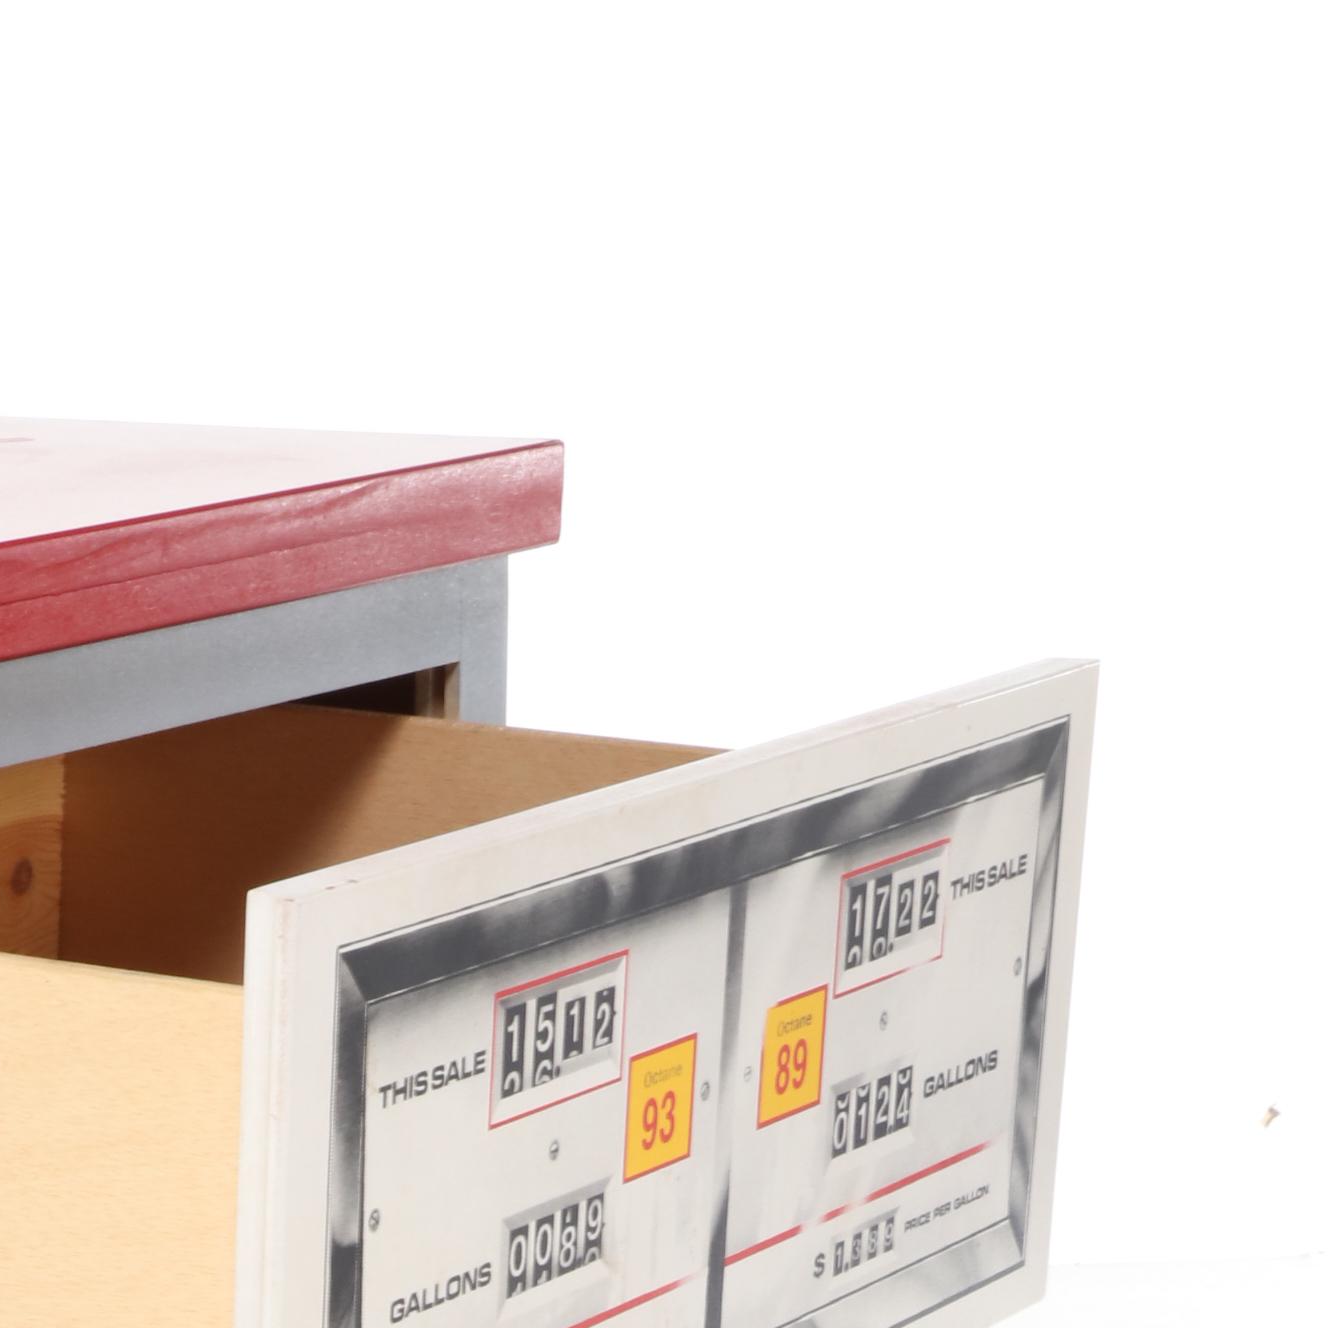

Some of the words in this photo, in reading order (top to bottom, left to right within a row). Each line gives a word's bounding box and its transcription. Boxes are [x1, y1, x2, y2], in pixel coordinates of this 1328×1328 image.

[950, 870, 986, 900] THIS
[987, 853, 1028, 888] SALE
[378, 1070, 429, 1109] THIS
[431, 1050, 487, 1091] SALE
[774, 1038, 808, 1096] 89
[922, 1050, 999, 1099] GALLONS
[641, 1090, 676, 1151] 93
[389, 1261, 492, 1324] GALLONS
